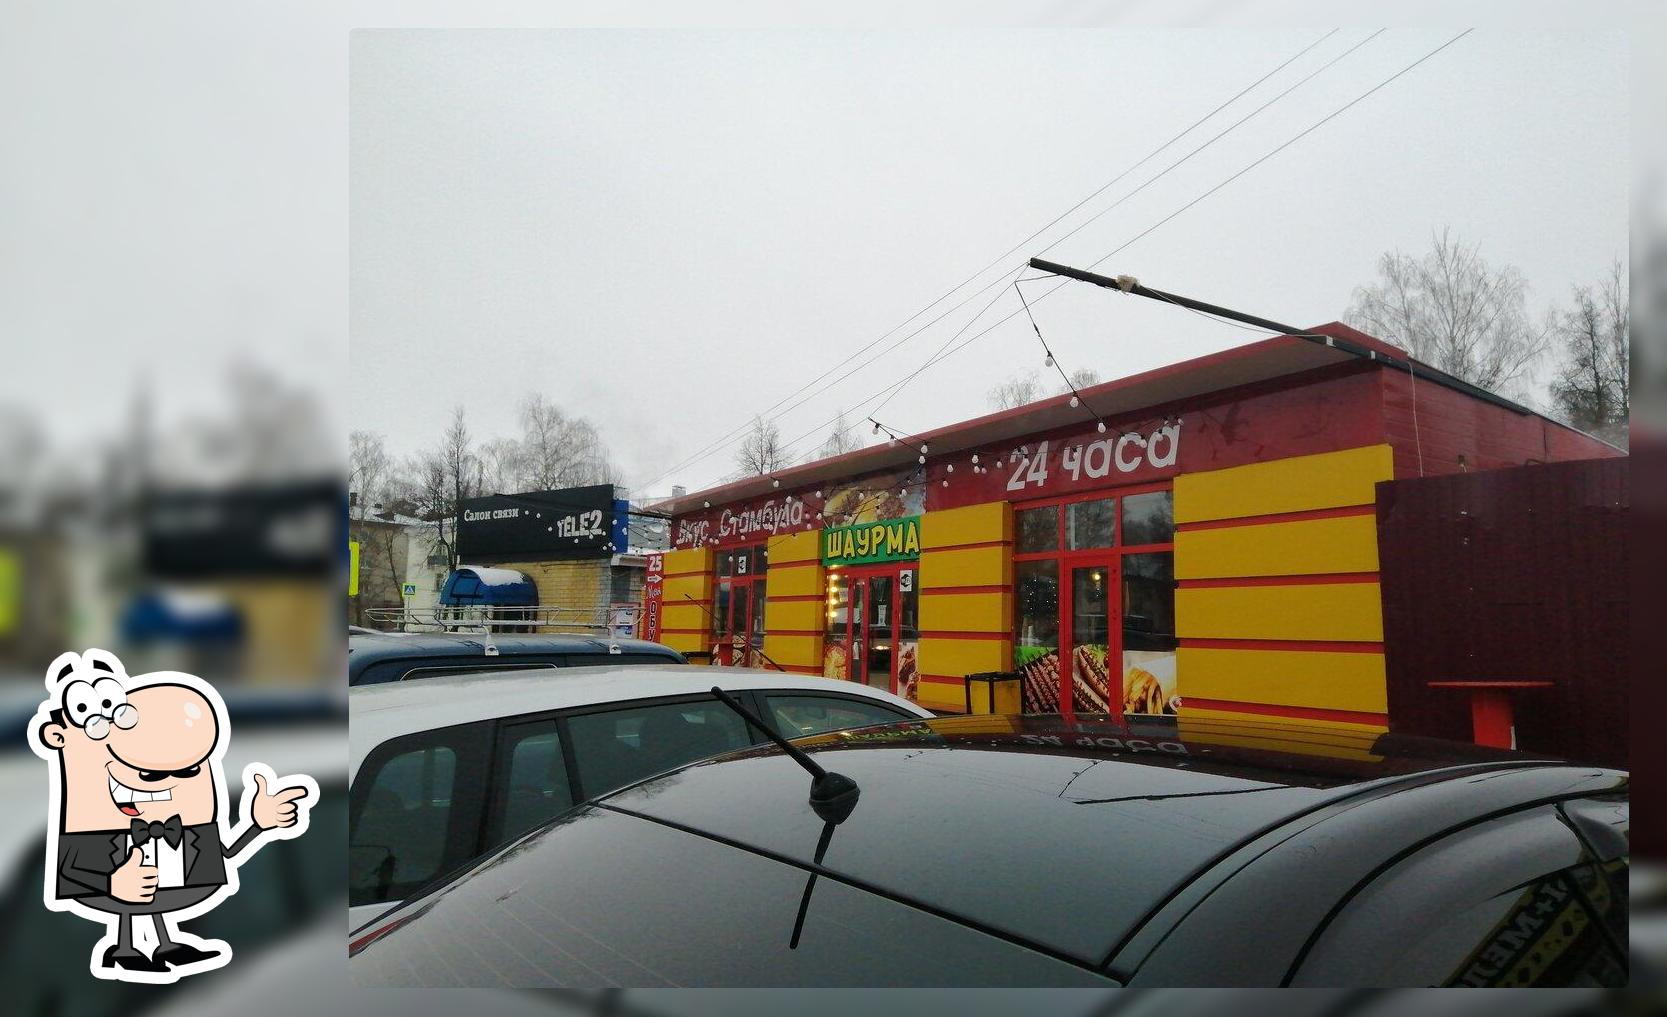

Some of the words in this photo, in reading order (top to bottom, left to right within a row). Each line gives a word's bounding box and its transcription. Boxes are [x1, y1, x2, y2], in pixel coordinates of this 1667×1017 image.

[1007, 440, 1049, 491] 24
[1062, 425, 1181, 481] часа
[464, 509, 491, 522] Салон
[492, 508, 520, 520] связи
[556, 509, 604, 538] TELE2
[719, 500, 804, 535] Стамбула
[827, 521, 920, 559] ШАУРМА
[648, 555, 663, 572] 25
